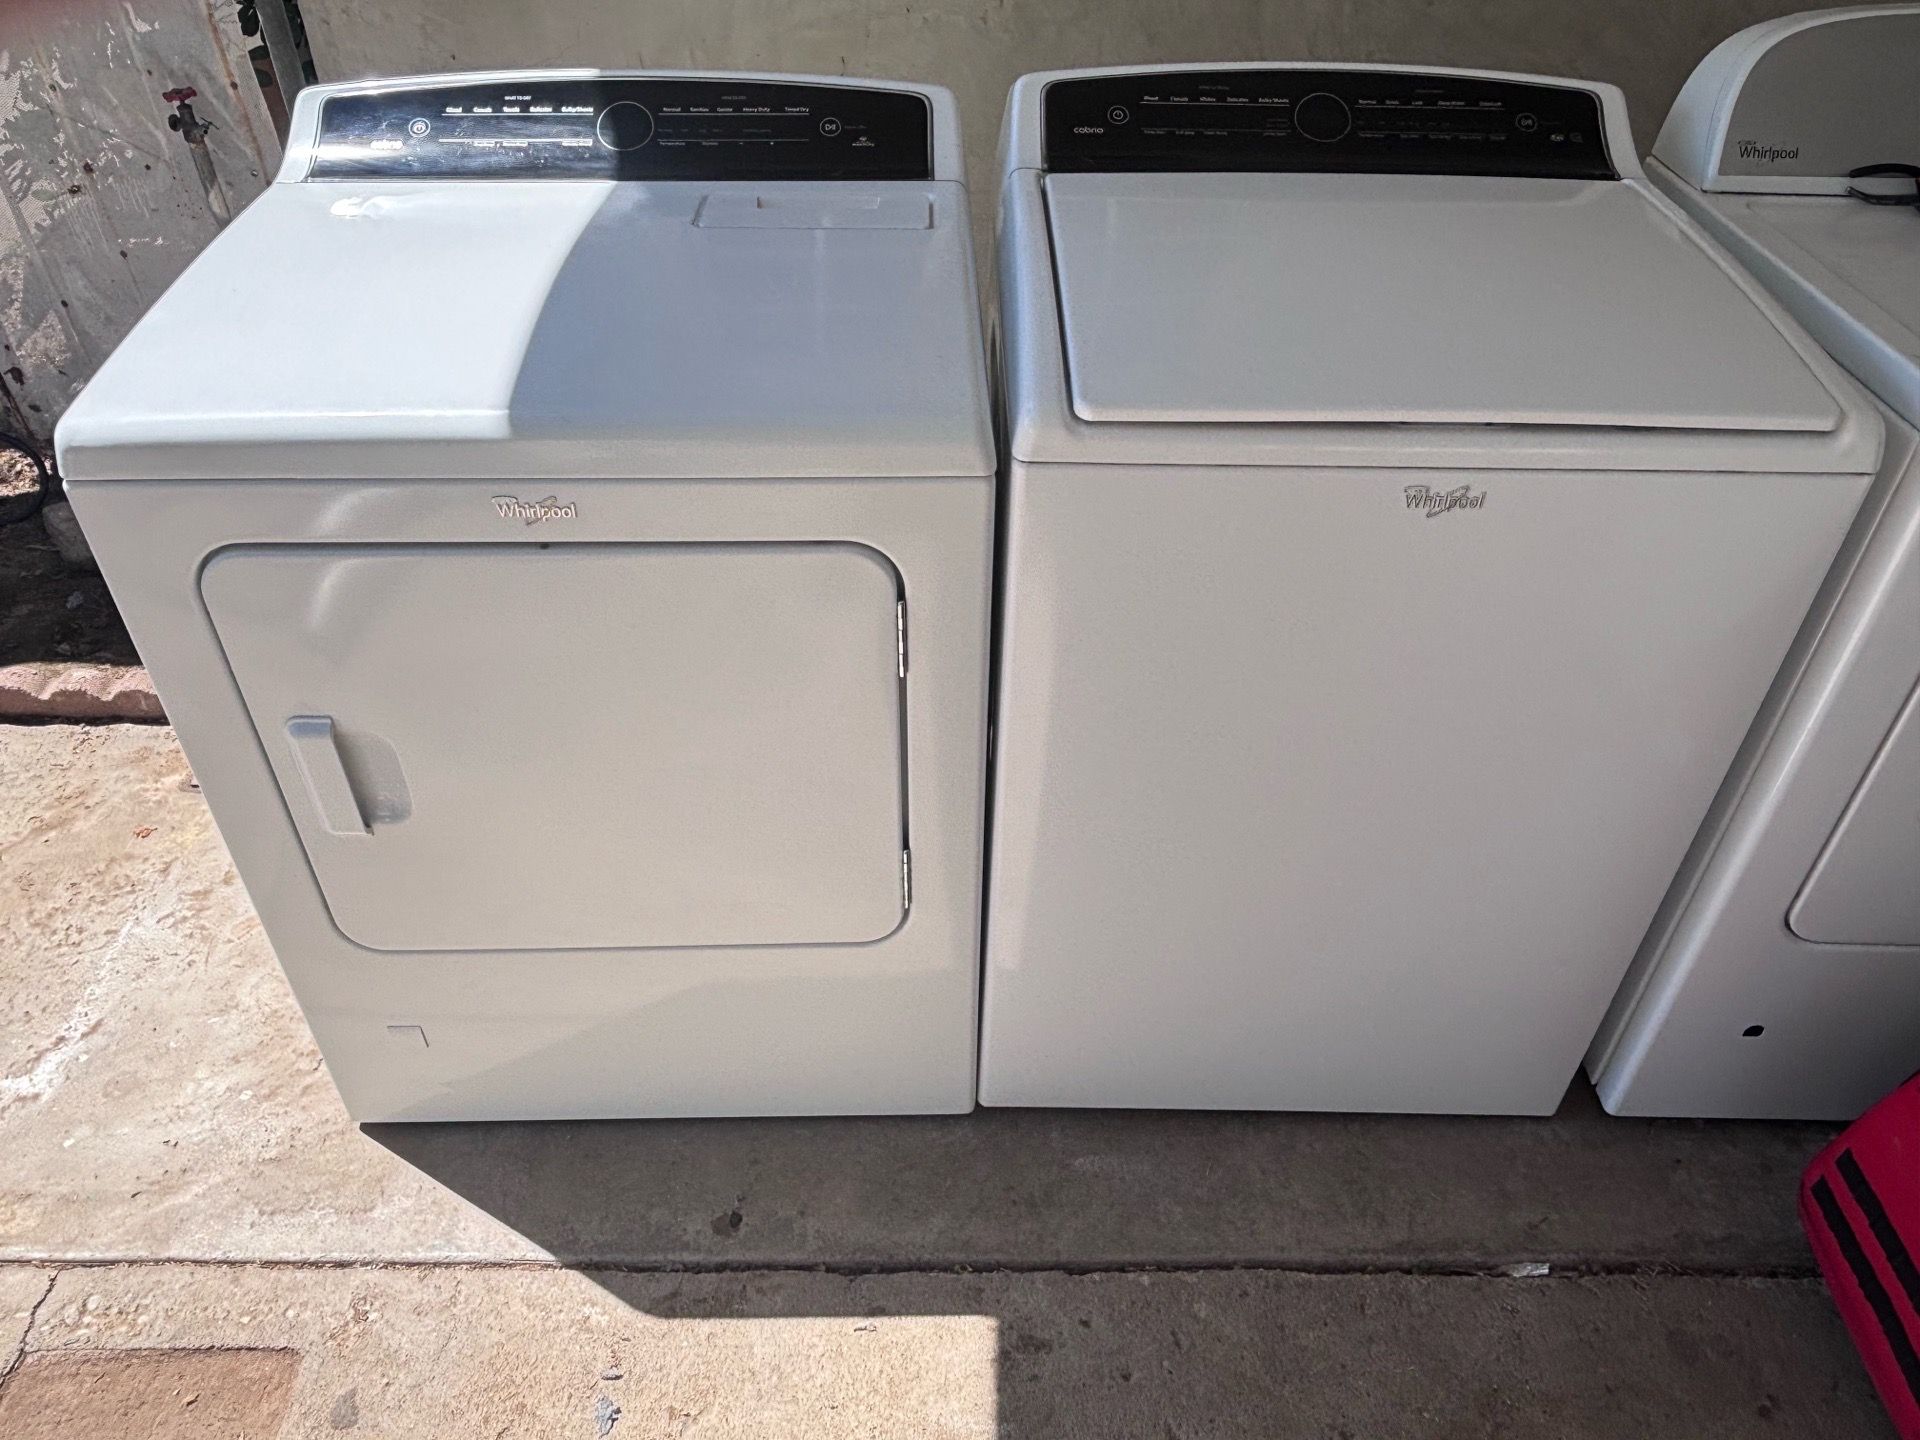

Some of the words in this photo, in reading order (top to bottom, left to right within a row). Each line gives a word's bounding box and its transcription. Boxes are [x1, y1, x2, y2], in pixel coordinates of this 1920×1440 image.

[1739, 145, 1799, 162] Whirlpool
[493, 498, 578, 522] Whirlpool
[1404, 489, 1487, 513] Whirlpool
